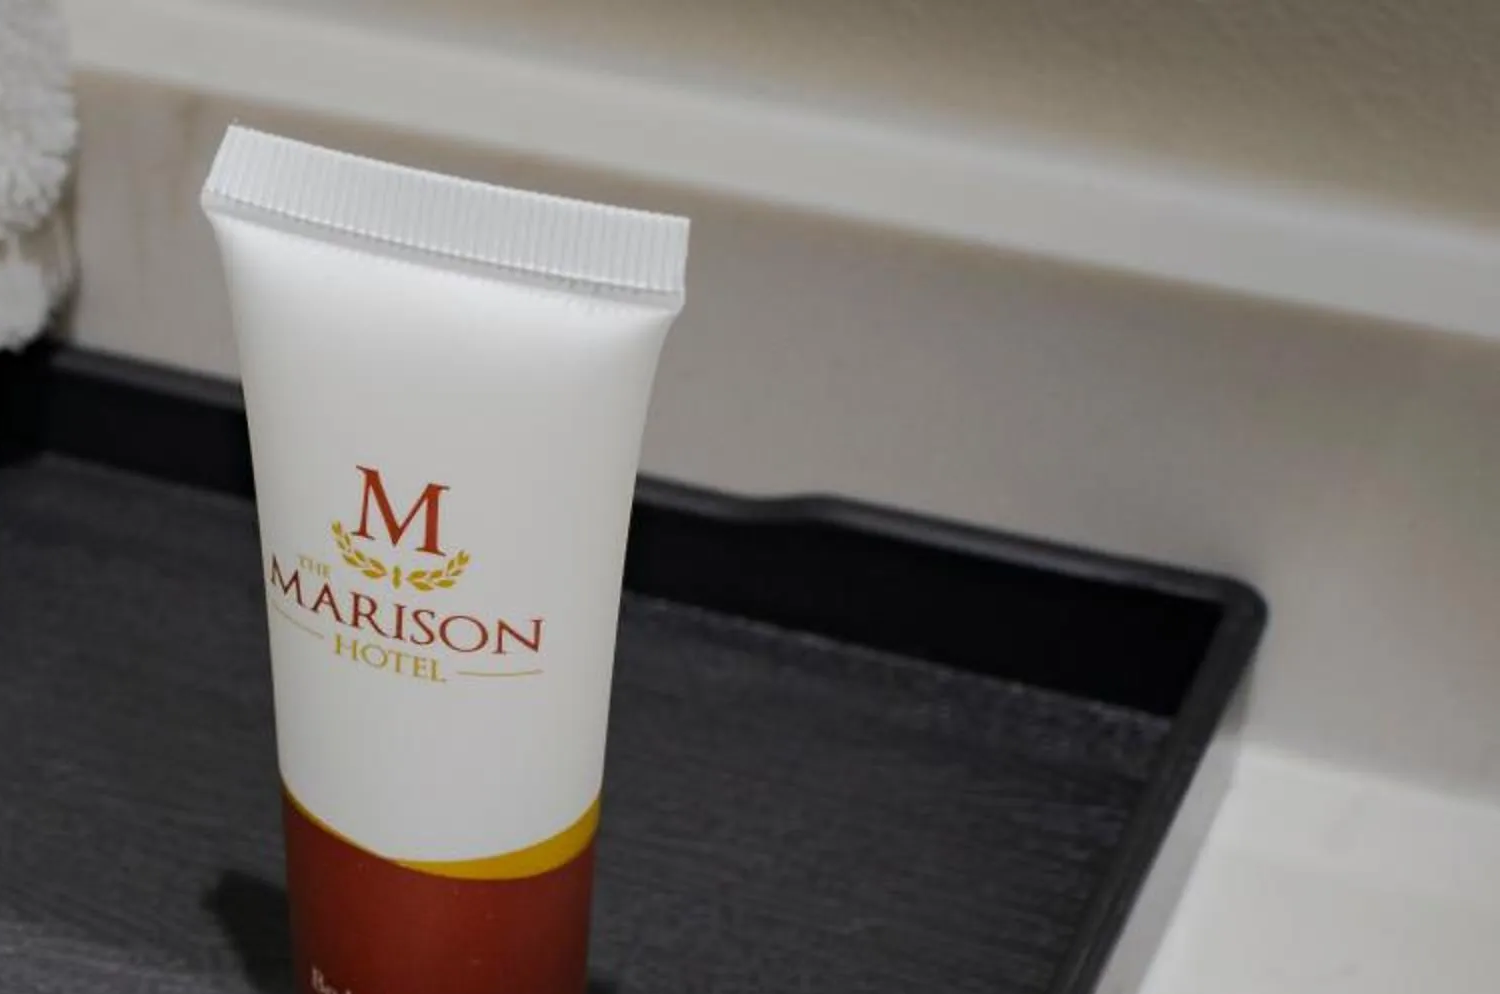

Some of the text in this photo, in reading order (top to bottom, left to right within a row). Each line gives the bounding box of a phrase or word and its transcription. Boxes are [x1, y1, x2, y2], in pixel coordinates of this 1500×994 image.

[351, 465, 450, 557] M
[297, 554, 331, 578] THE
[269, 553, 544, 655] MARISON
[334, 633, 447, 682] HOTEL
